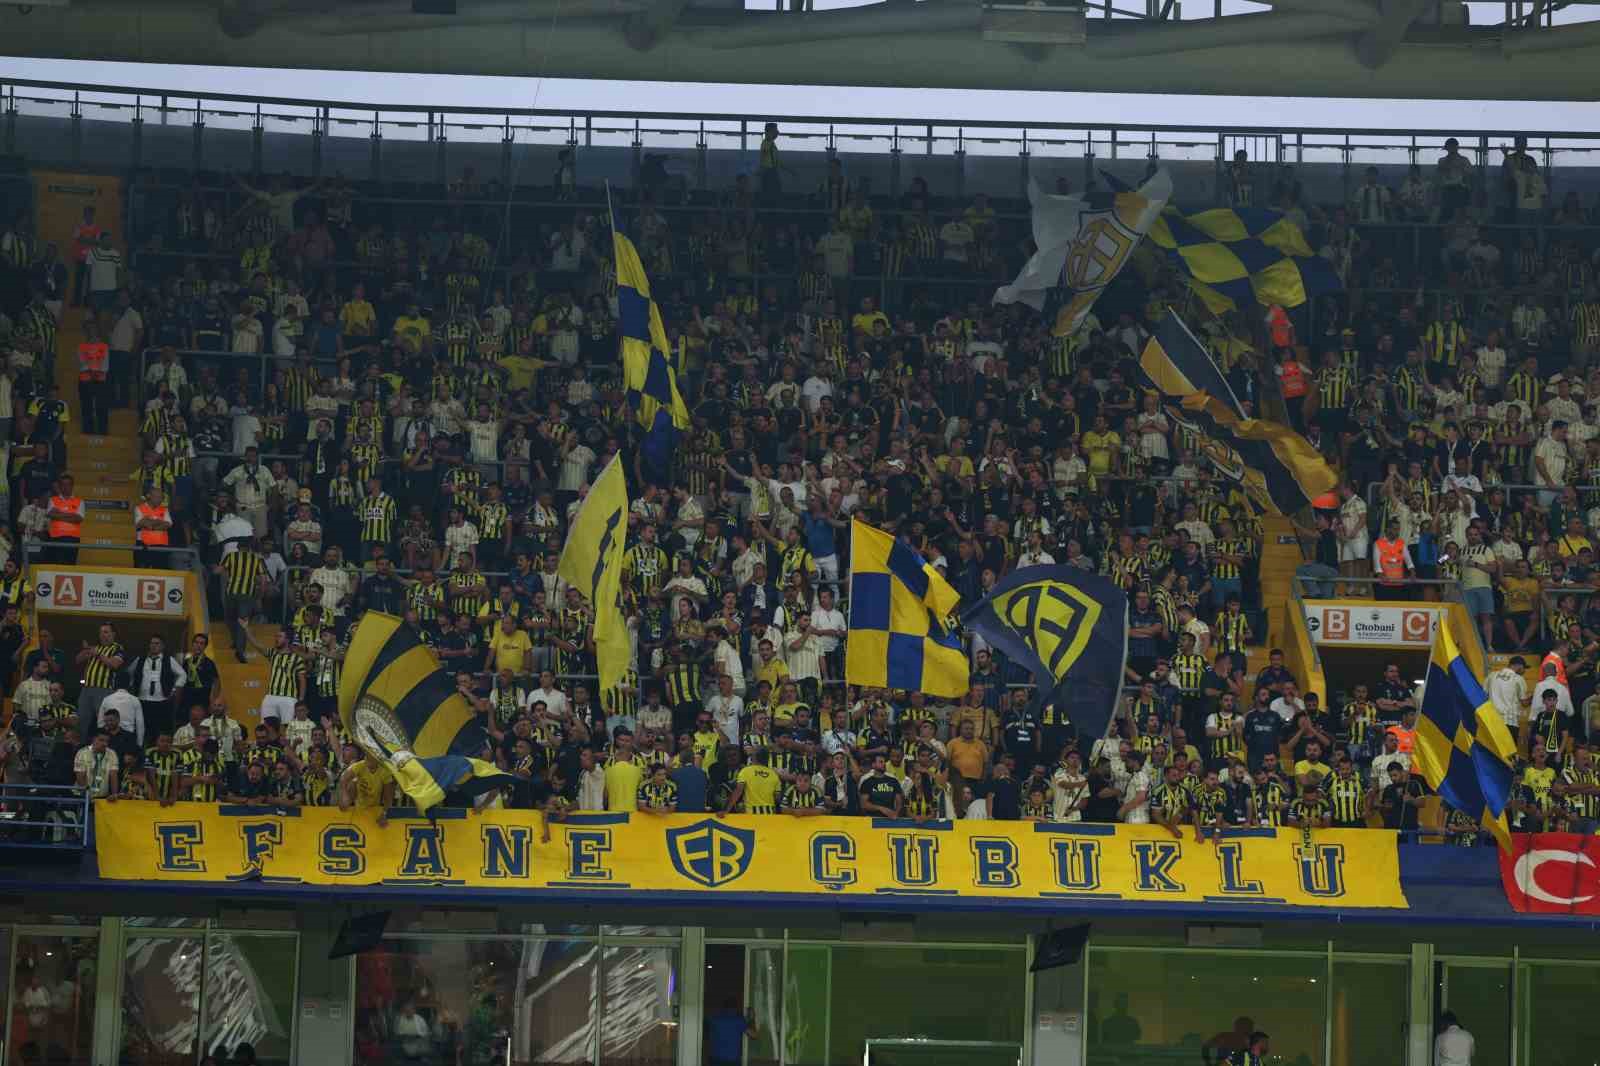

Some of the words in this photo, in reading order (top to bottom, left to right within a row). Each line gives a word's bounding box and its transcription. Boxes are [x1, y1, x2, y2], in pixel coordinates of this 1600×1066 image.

[58, 577, 77, 601] A
[88, 589, 129, 603] Chobani
[142, 581, 161, 604] B
[1328, 610, 1346, 633] B
[1355, 622, 1395, 633] Chobani
[1406, 613, 1426, 634] C
[155, 820, 612, 880] EFSANE
[675, 827, 745, 883] FB
[808, 830, 1346, 897] ÇUBUKLU
